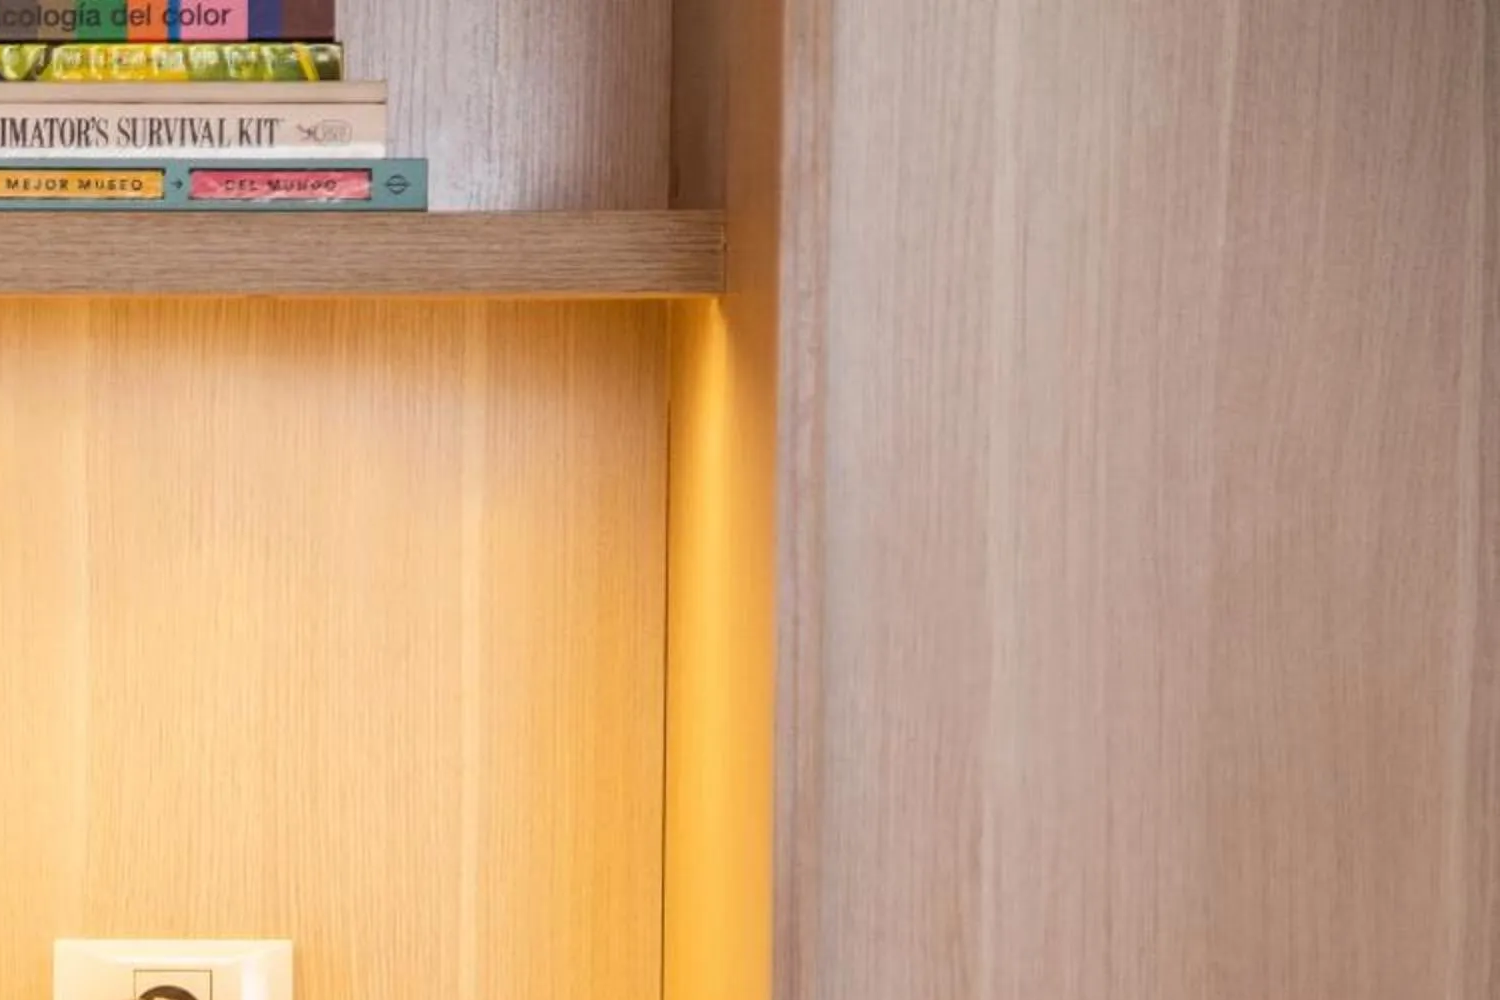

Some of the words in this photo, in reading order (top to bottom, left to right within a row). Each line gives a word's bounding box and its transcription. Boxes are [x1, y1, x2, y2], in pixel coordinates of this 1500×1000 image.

[110, 4, 152, 27] del
[162, 4, 232, 26] color
[116, 117, 231, 148] SURVIVAL
[237, 117, 279, 148] KIT
[4, 178, 70, 191] MEJOR
[77, 178, 144, 191] MUSEO
[223, 178, 259, 191] DEL
